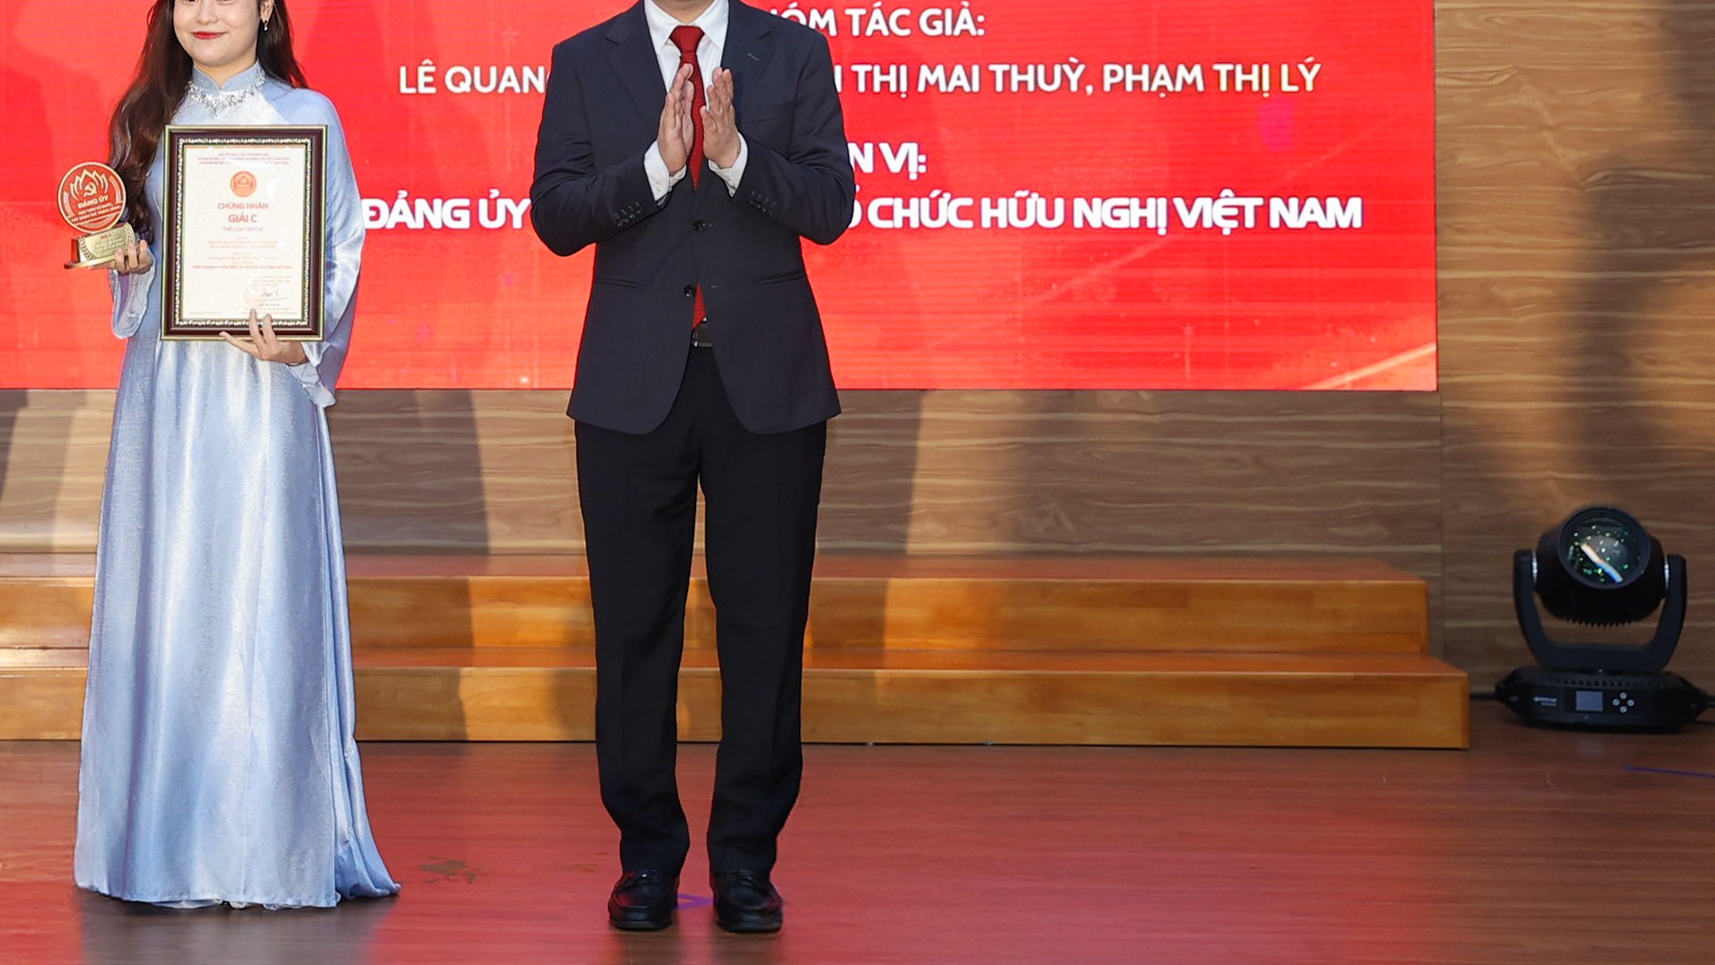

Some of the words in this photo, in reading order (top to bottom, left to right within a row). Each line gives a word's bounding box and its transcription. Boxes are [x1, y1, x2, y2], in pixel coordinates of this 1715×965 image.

[770, 1, 838, 36] ÓM
[844, 1, 911, 36] TÁC
[919, 0, 985, 36] GIẢ:
[399, 58, 437, 94] LÊ
[444, 65, 551, 93] QUAN
[850, 64, 908, 98] THỊ
[917, 64, 980, 93] MAI
[988, 56, 1094, 96] THUỲ,
[1102, 63, 1205, 98] PHẠM
[1212, 63, 1270, 98] THỊ
[1280, 56, 1322, 92] LÝ
[878, 142, 927, 181] VỊ:
[250, 214, 258, 223] C
[361, 189, 471, 230] ĐẢNG
[478, 188, 532, 230] ỦY
[867, 189, 974, 229] CHỨC
[981, 189, 1065, 229] HỮU
[1073, 196, 1167, 236] NGHỊ
[1172, 188, 1264, 236] VIỆT
[1269, 196, 1363, 229] NAM
